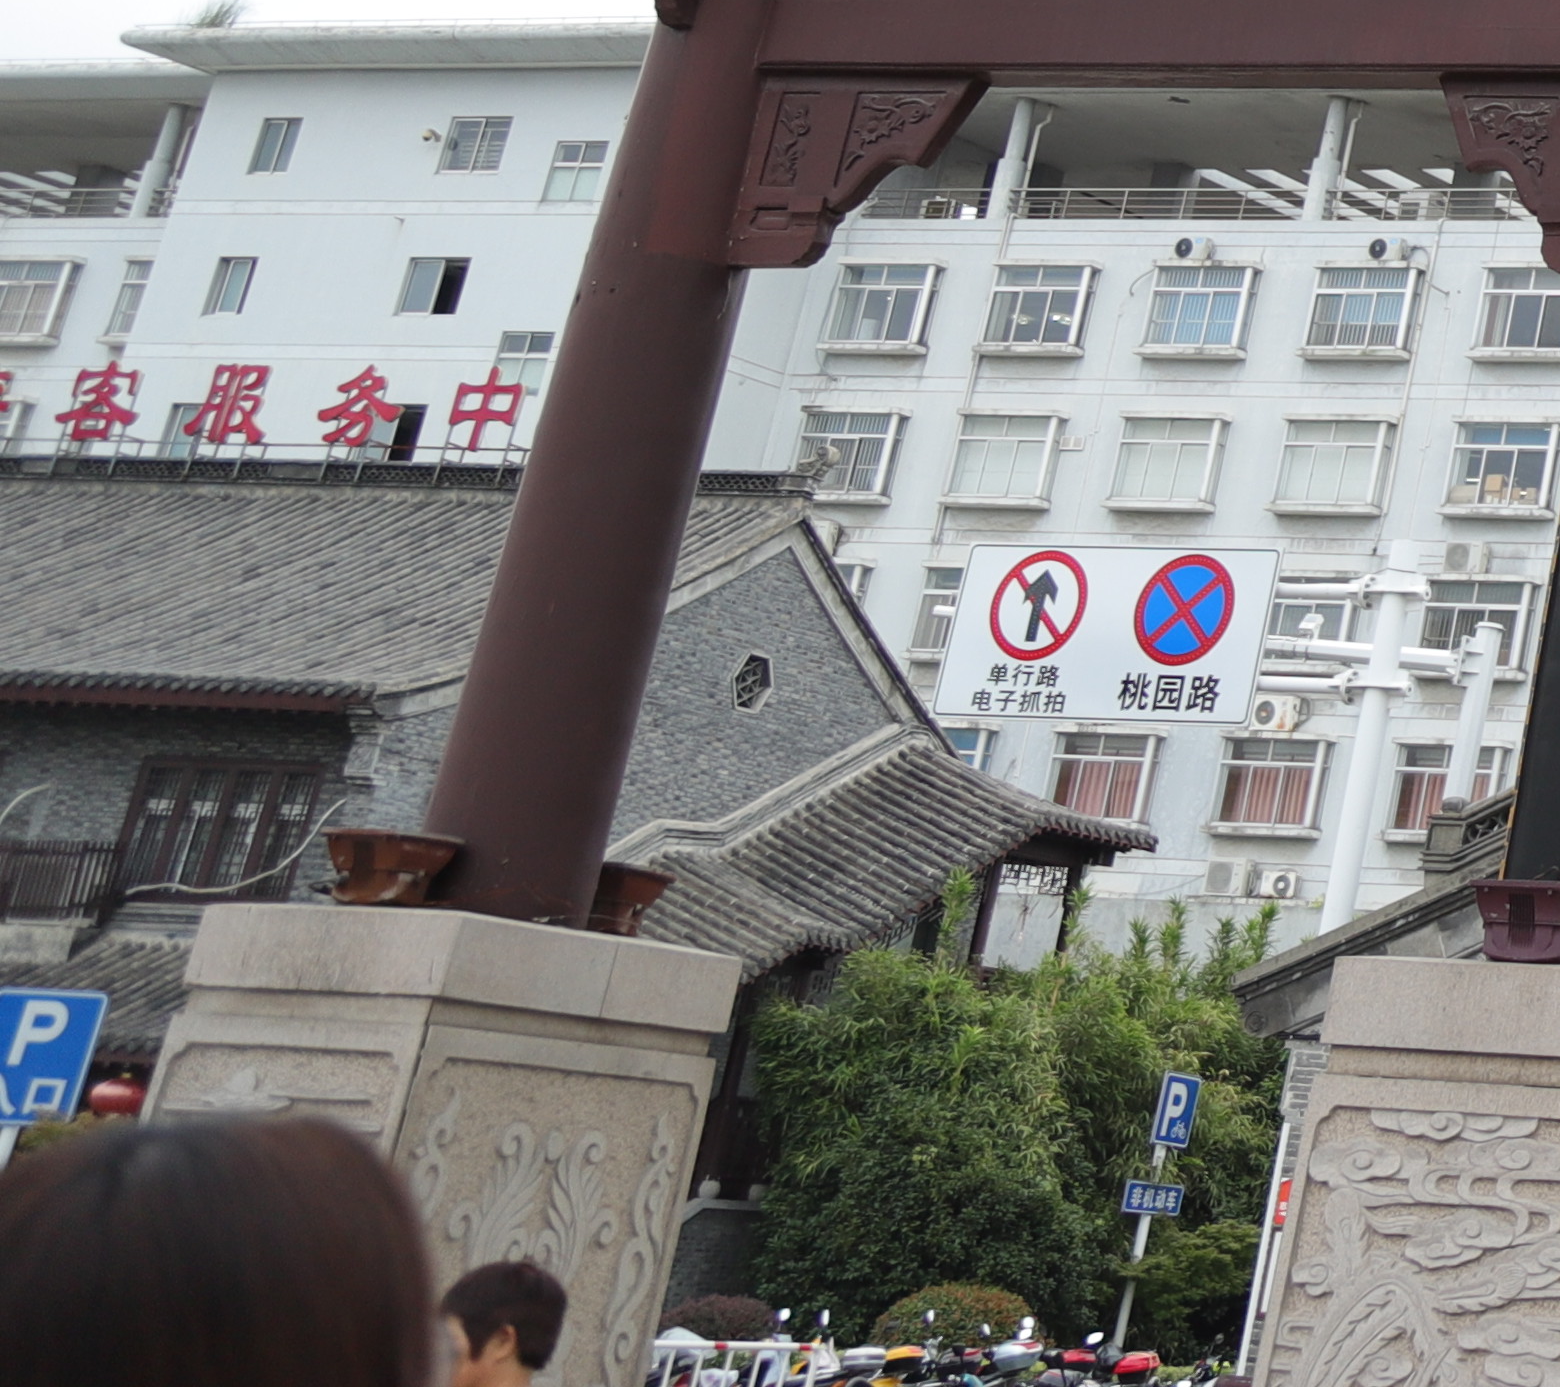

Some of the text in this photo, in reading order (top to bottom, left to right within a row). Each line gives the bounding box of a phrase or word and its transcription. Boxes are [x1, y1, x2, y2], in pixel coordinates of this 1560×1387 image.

[0, 360, 527, 452] 客服务中
[986, 662, 1061, 688] 单行路
[1117, 671, 1222, 715] 桃园路
[971, 687, 1067, 715] 电子抓拍
[6, 999, 70, 1066] P
[1160, 1081, 1190, 1137] P
[1130, 1185, 1178, 1211] 非机动车
